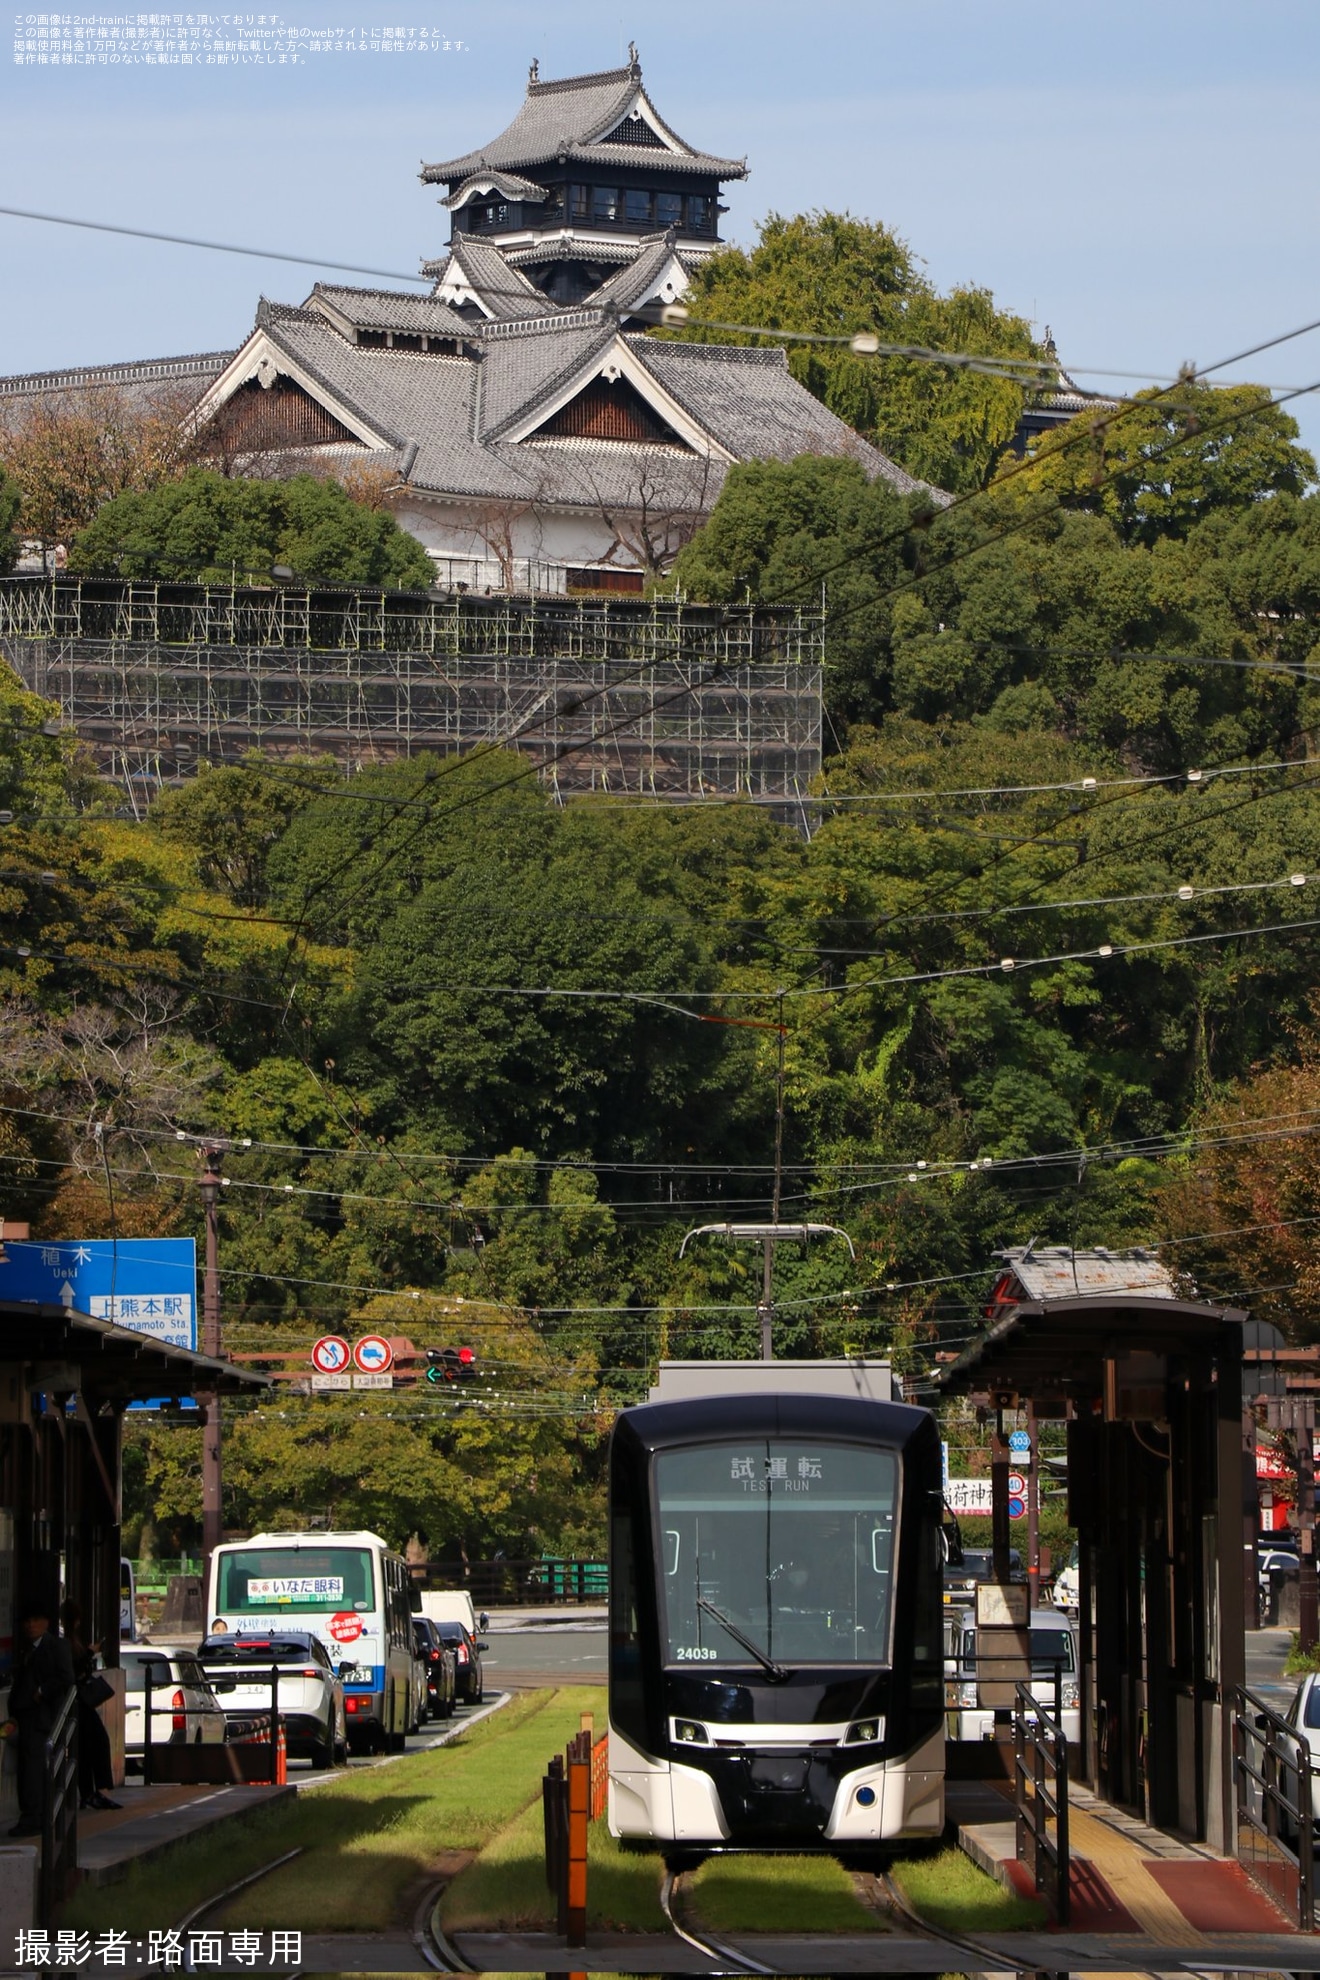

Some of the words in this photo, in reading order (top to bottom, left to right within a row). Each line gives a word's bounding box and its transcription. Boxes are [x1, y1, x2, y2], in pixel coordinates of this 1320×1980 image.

[41, 1246, 91, 1266] 植木
[53, 1267, 78, 1278] Ueki
[99, 1297, 183, 1318] 上熊本駅
[731, 1457, 822, 1479] 試運転
[741, 1480, 775, 1492] TEST
[785, 1480, 809, 1492] RUN
[273, 1579, 341, 1593] いなだ眼科
[677, 1648, 717, 1660] 2403B
